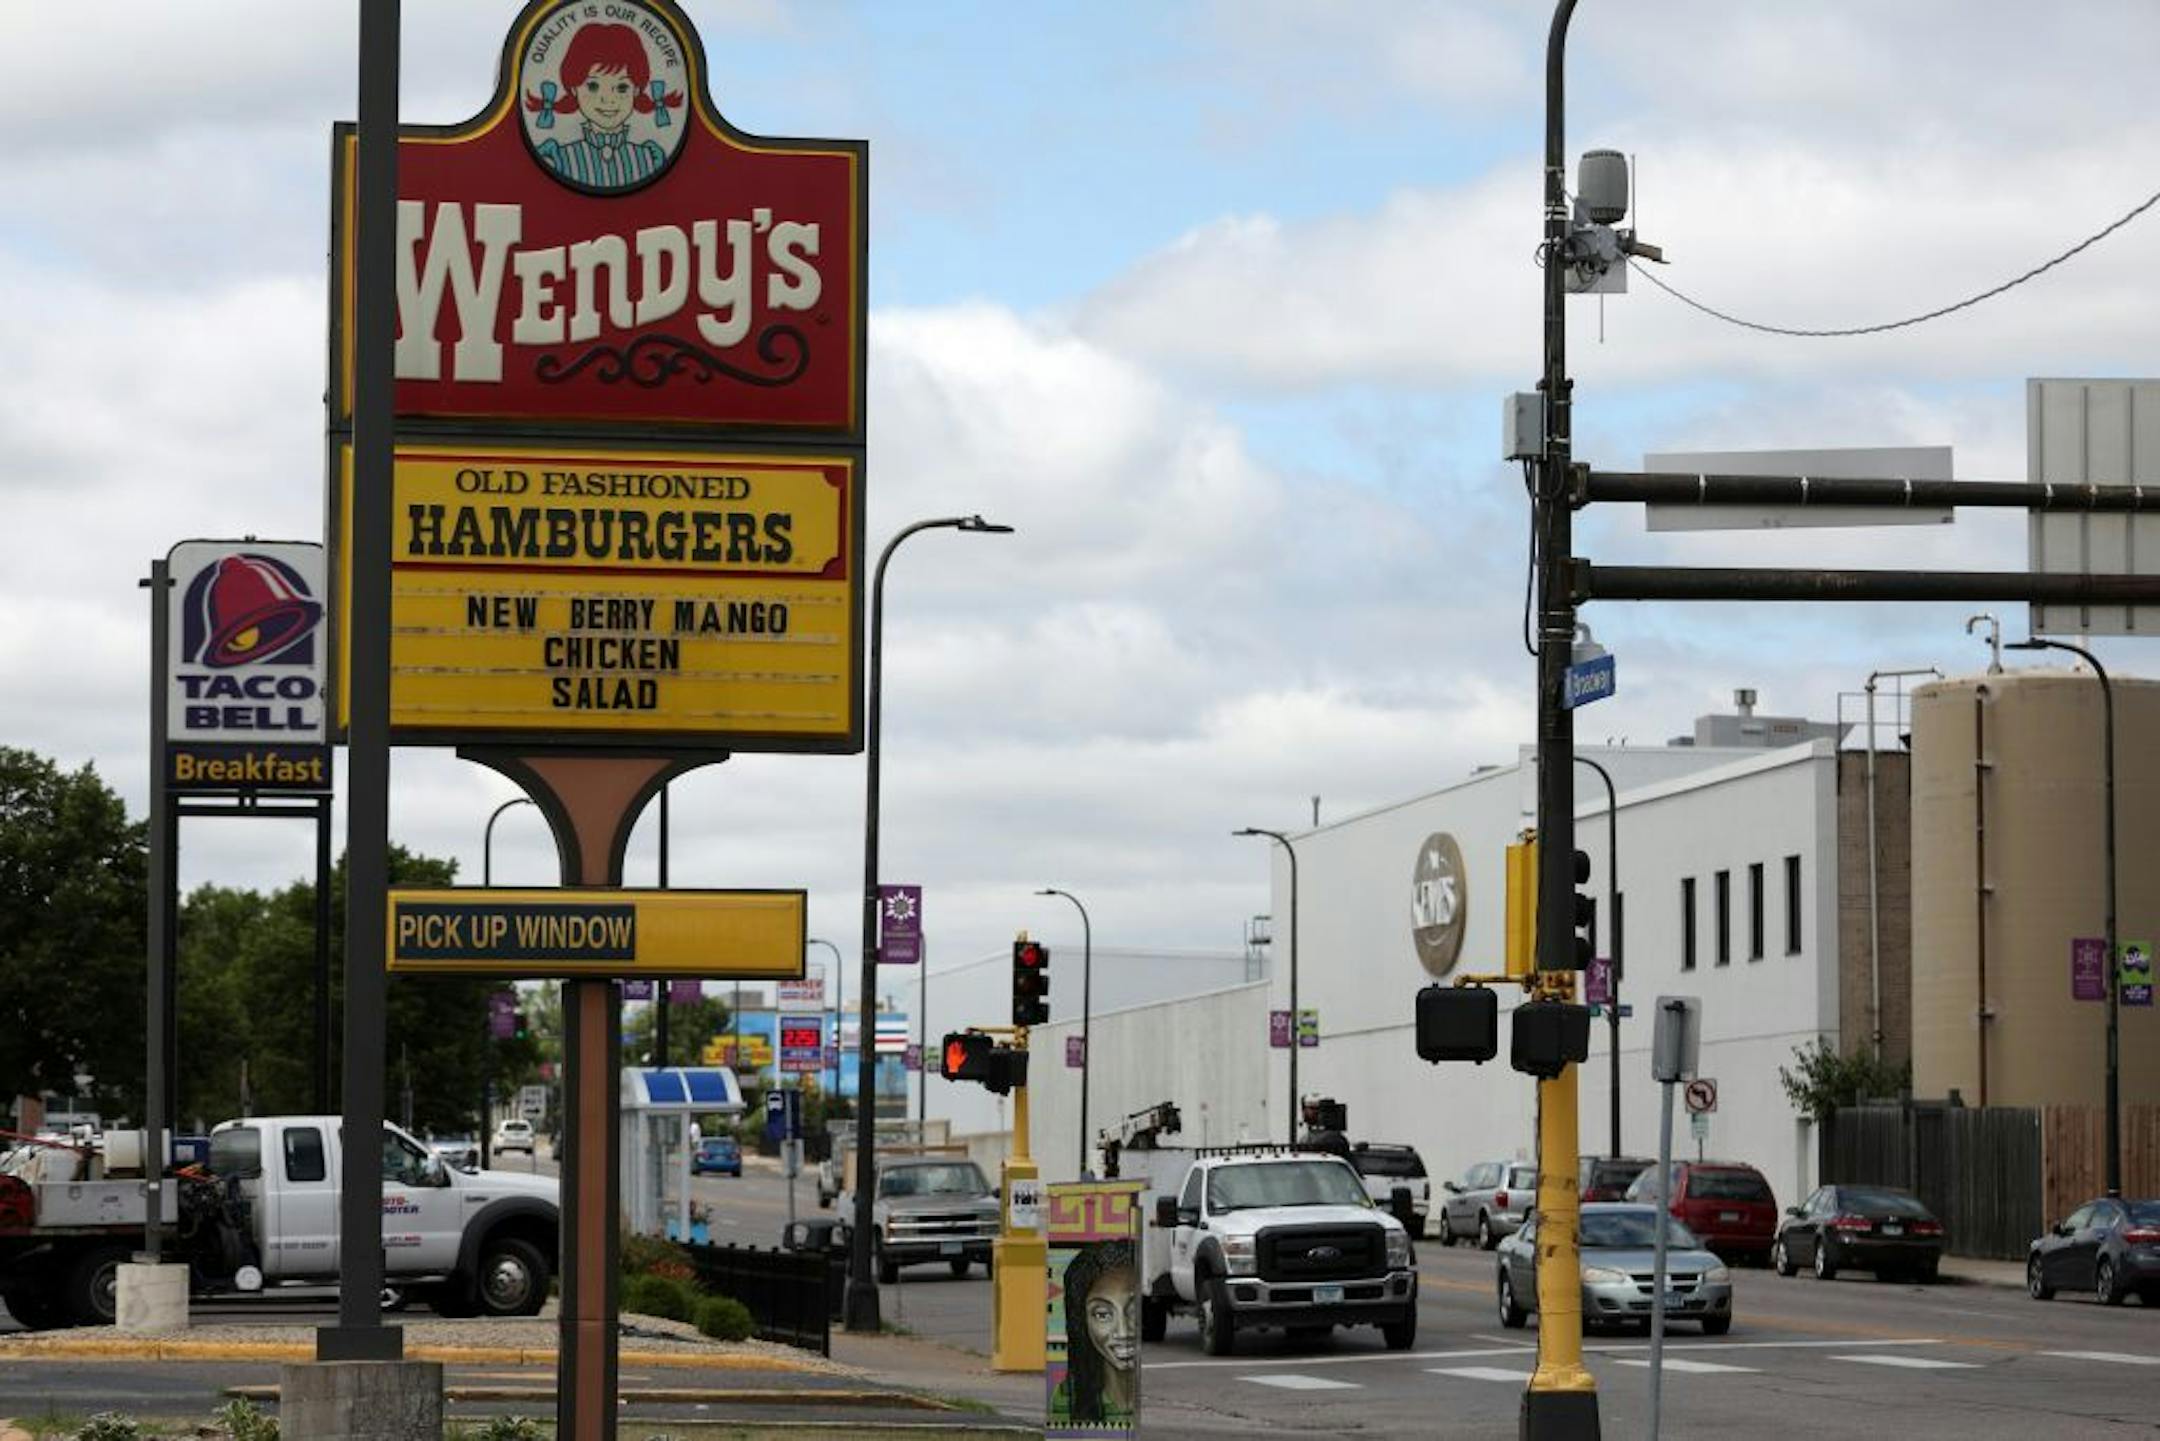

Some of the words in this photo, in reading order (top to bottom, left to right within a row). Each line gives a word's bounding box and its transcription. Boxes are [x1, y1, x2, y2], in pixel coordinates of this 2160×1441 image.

[532, 10, 577, 64] QUALITY
[584, 5, 598, 18] IS
[605, 4, 636, 23] OUR
[640, 19, 679, 68] RECIPE
[455, 468, 528, 494] OLD
[541, 472, 751, 500] FASHIONED
[408, 504, 793, 564] HAMBURGERS
[467, 595, 538, 630] NEW
[571, 599, 654, 632] BERRY
[674, 601, 788, 634] MANGO
[544, 636, 680, 670] CHICKEN
[176, 675, 317, 700] TACO
[552, 677, 659, 710] SALAD
[185, 706, 318, 730] BELL
[175, 753, 323, 781] Breakfast
[399, 914, 463, 948] PICK
[471, 915, 508, 948] UP
[515, 915, 633, 949] WINDOW
